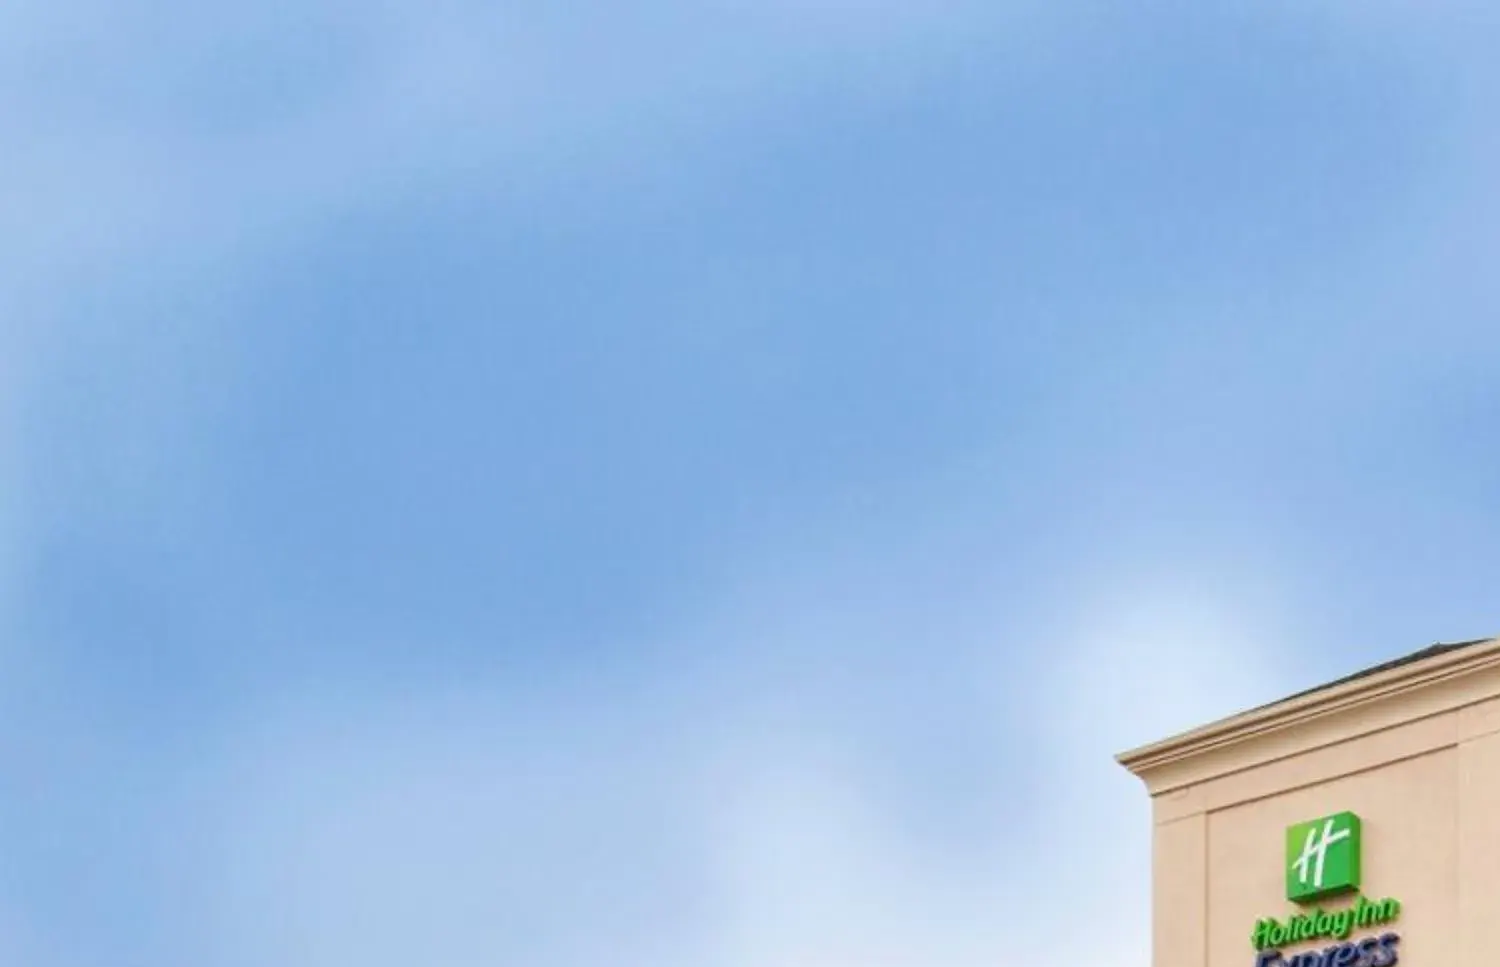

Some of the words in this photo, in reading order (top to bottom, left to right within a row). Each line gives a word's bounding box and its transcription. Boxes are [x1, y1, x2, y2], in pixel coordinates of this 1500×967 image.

[1292, 819, 1350, 887] H
[1252, 908, 1354, 950] Holiday
[1354, 897, 1401, 926] Inn
